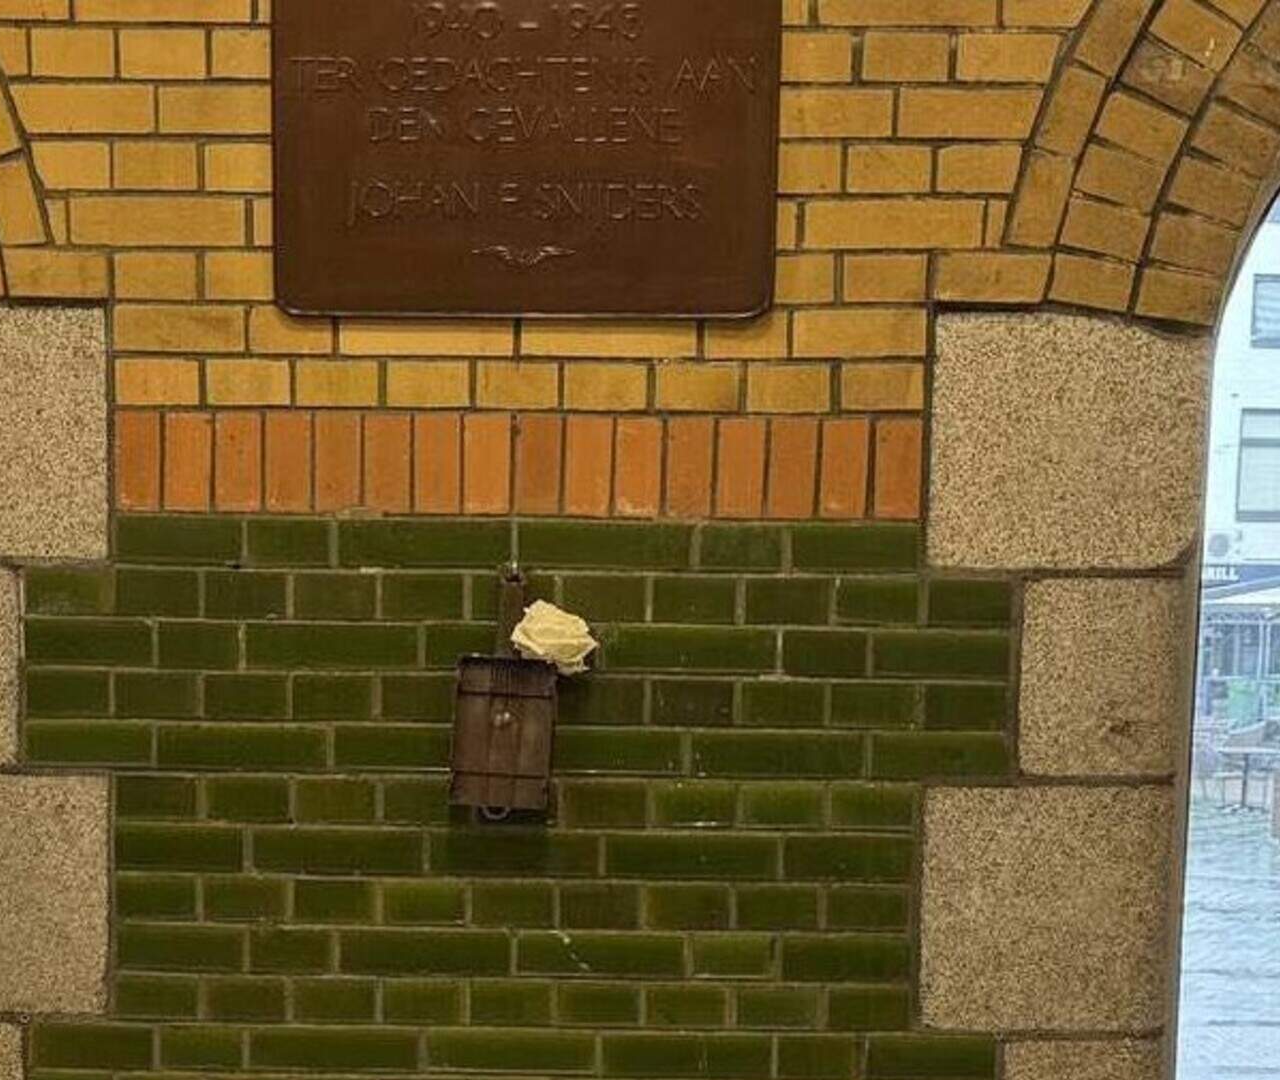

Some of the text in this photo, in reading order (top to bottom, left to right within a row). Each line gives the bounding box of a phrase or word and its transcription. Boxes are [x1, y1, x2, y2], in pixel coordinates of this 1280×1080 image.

[287, 56, 361, 94] TER
[672, 56, 758, 95] AAN
[367, 107, 446, 143] DEN
